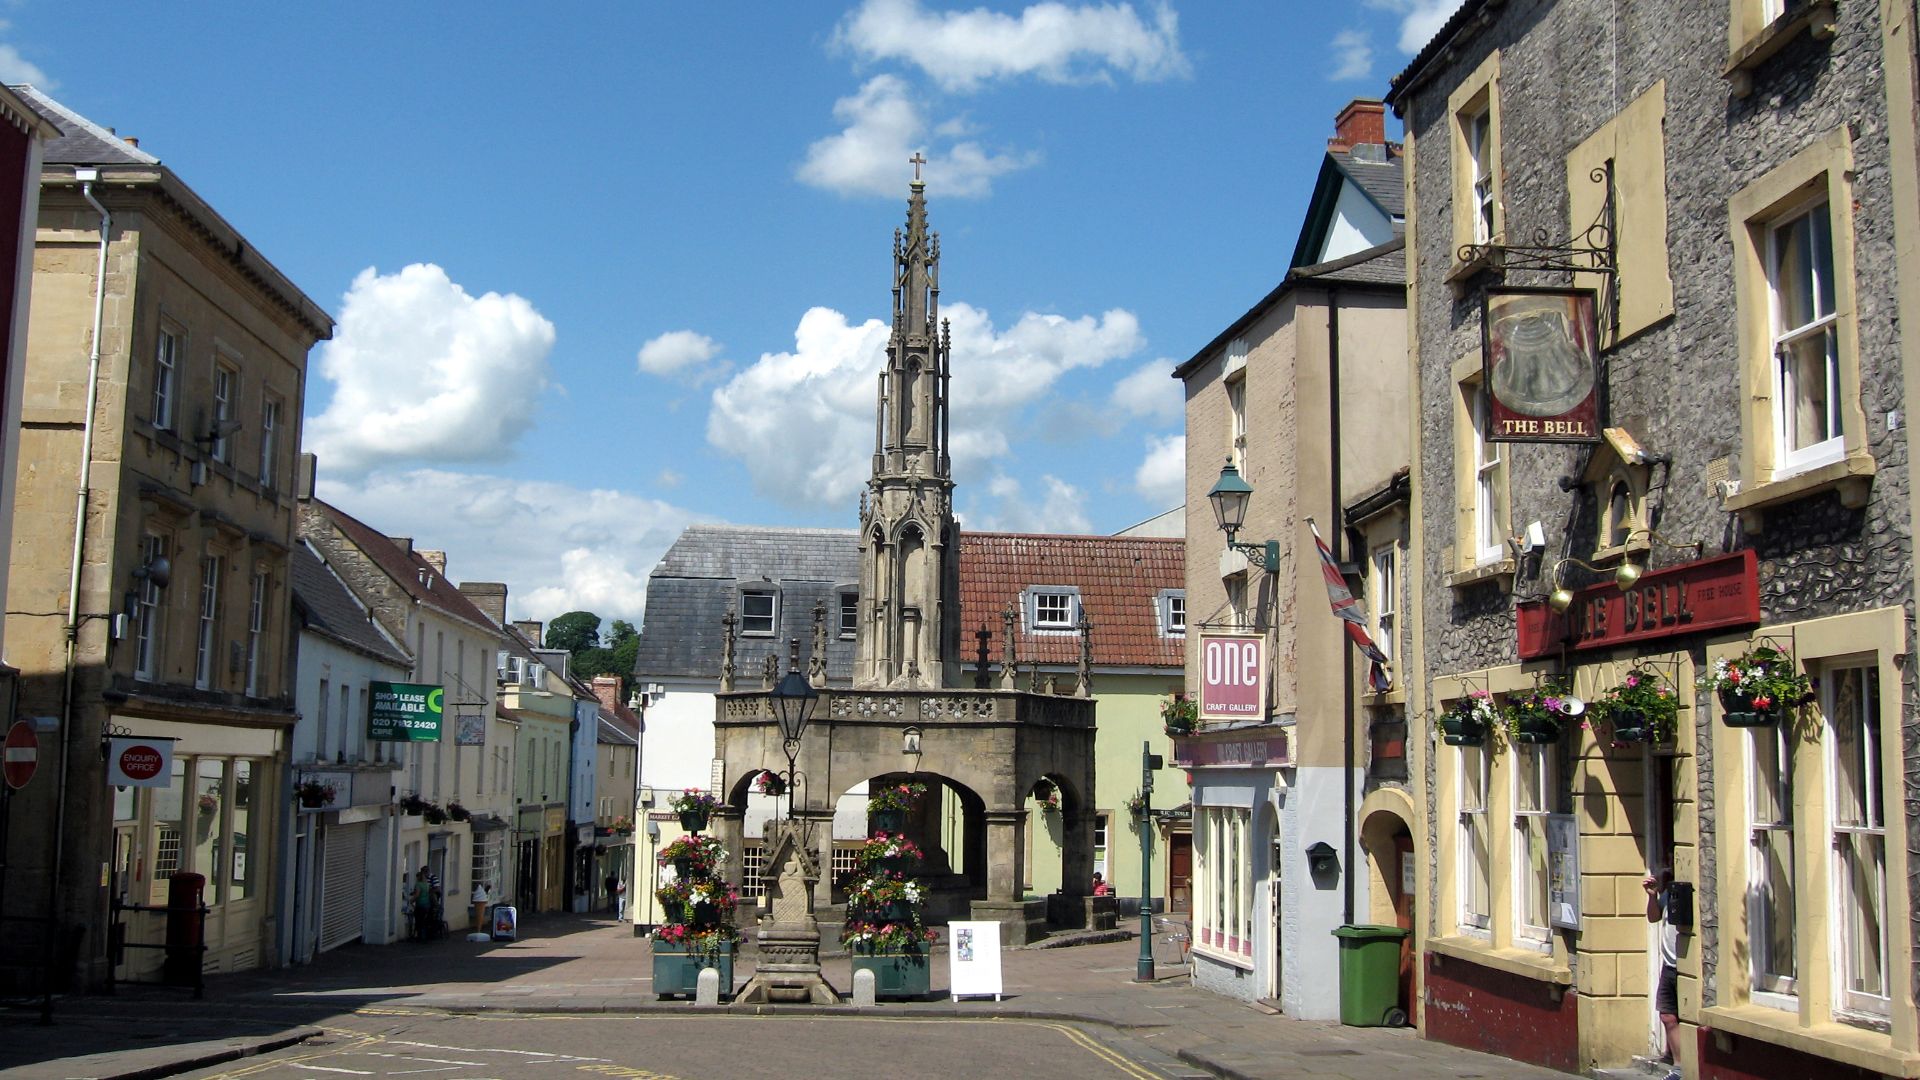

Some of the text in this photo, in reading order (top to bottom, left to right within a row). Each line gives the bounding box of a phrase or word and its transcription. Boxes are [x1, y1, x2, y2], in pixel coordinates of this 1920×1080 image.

[1502, 420, 1588, 436] THE BELL
[1697, 587, 1715, 602] FREE
[1623, 579, 1694, 634] BELL
[375, 692, 425, 703] SHOP LEASE
[374, 702, 425, 713] AVAILABLE
[1206, 703, 1257, 712] CRAFT GALLERY
[372, 719, 390, 727] 020
[413, 721, 437, 730] 2420
[1243, 741, 1267, 761] GALLERY
[123, 754, 159, 763] ENQUIRY
[126, 763, 155, 772] OFFICE
